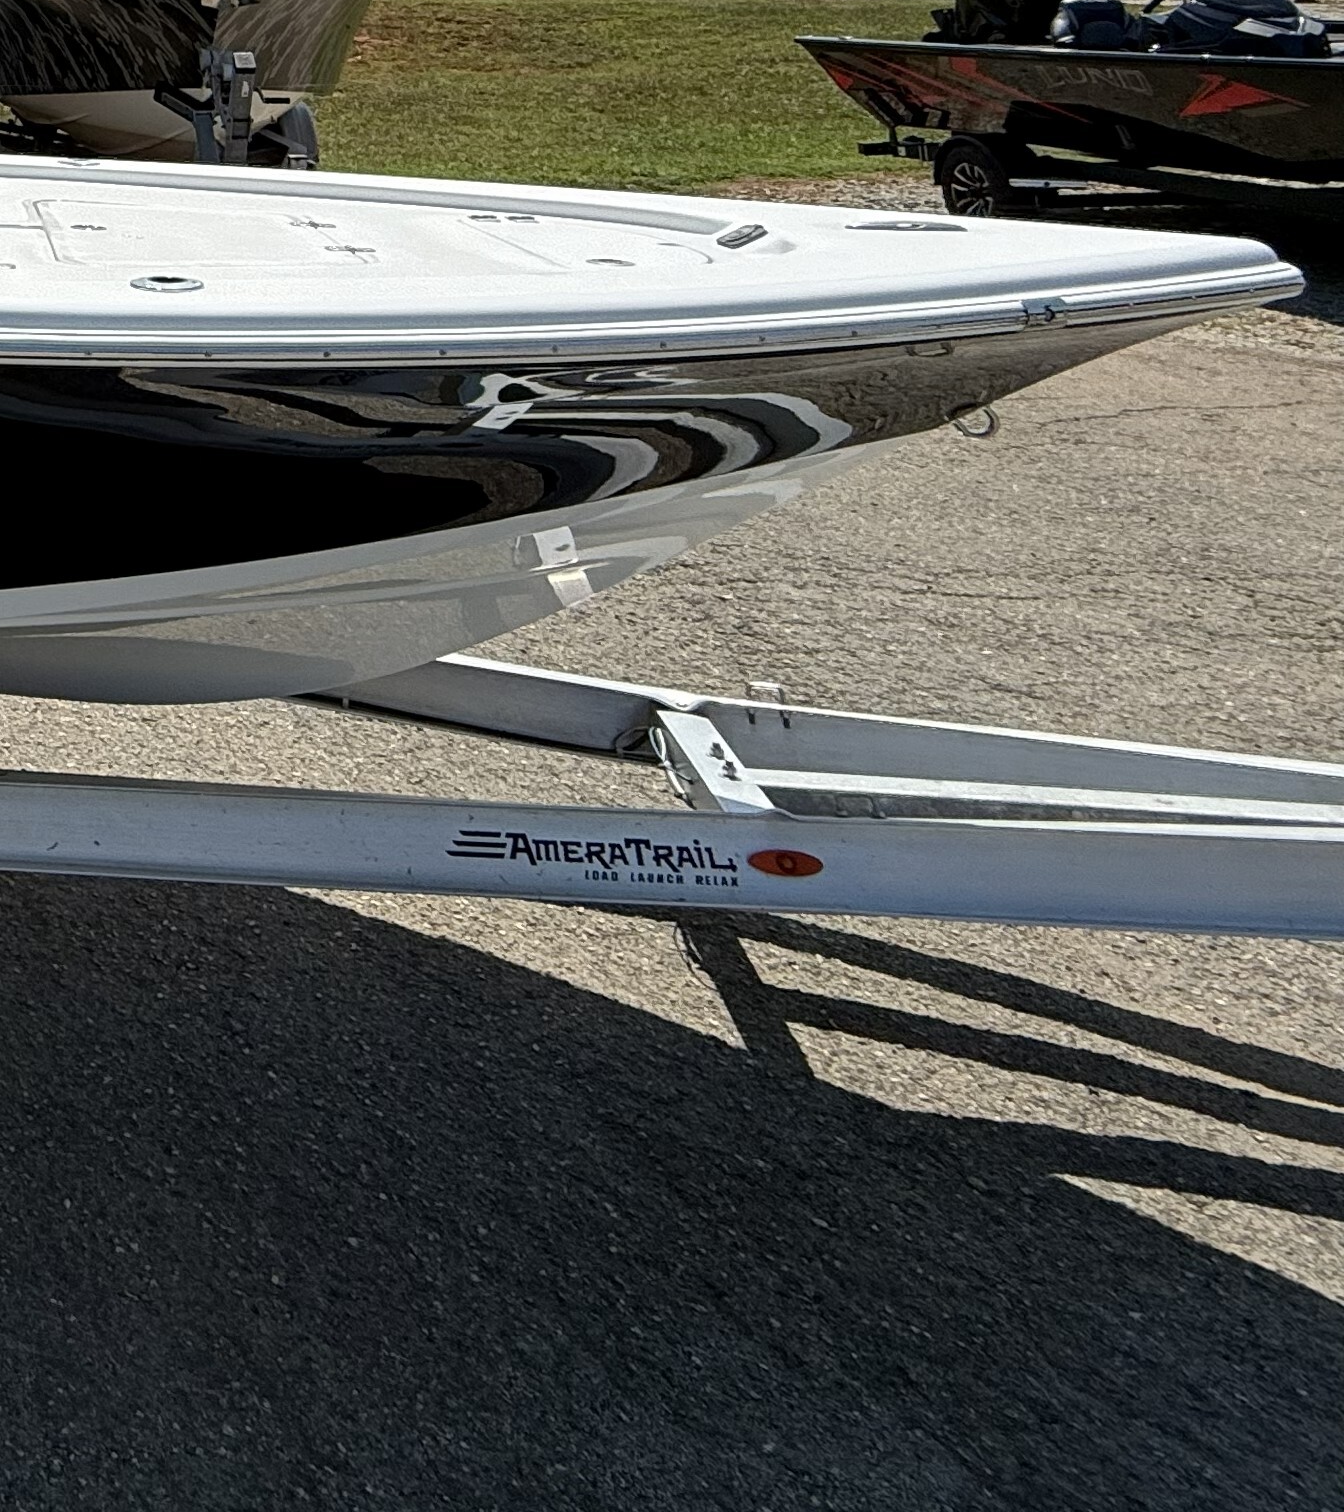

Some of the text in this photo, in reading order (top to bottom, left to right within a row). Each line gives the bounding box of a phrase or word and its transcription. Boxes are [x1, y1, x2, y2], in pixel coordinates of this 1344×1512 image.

[1034, 65, 1153, 96] LUND
[584, 870, 740, 888] LOAD LAUNCH RELAX
